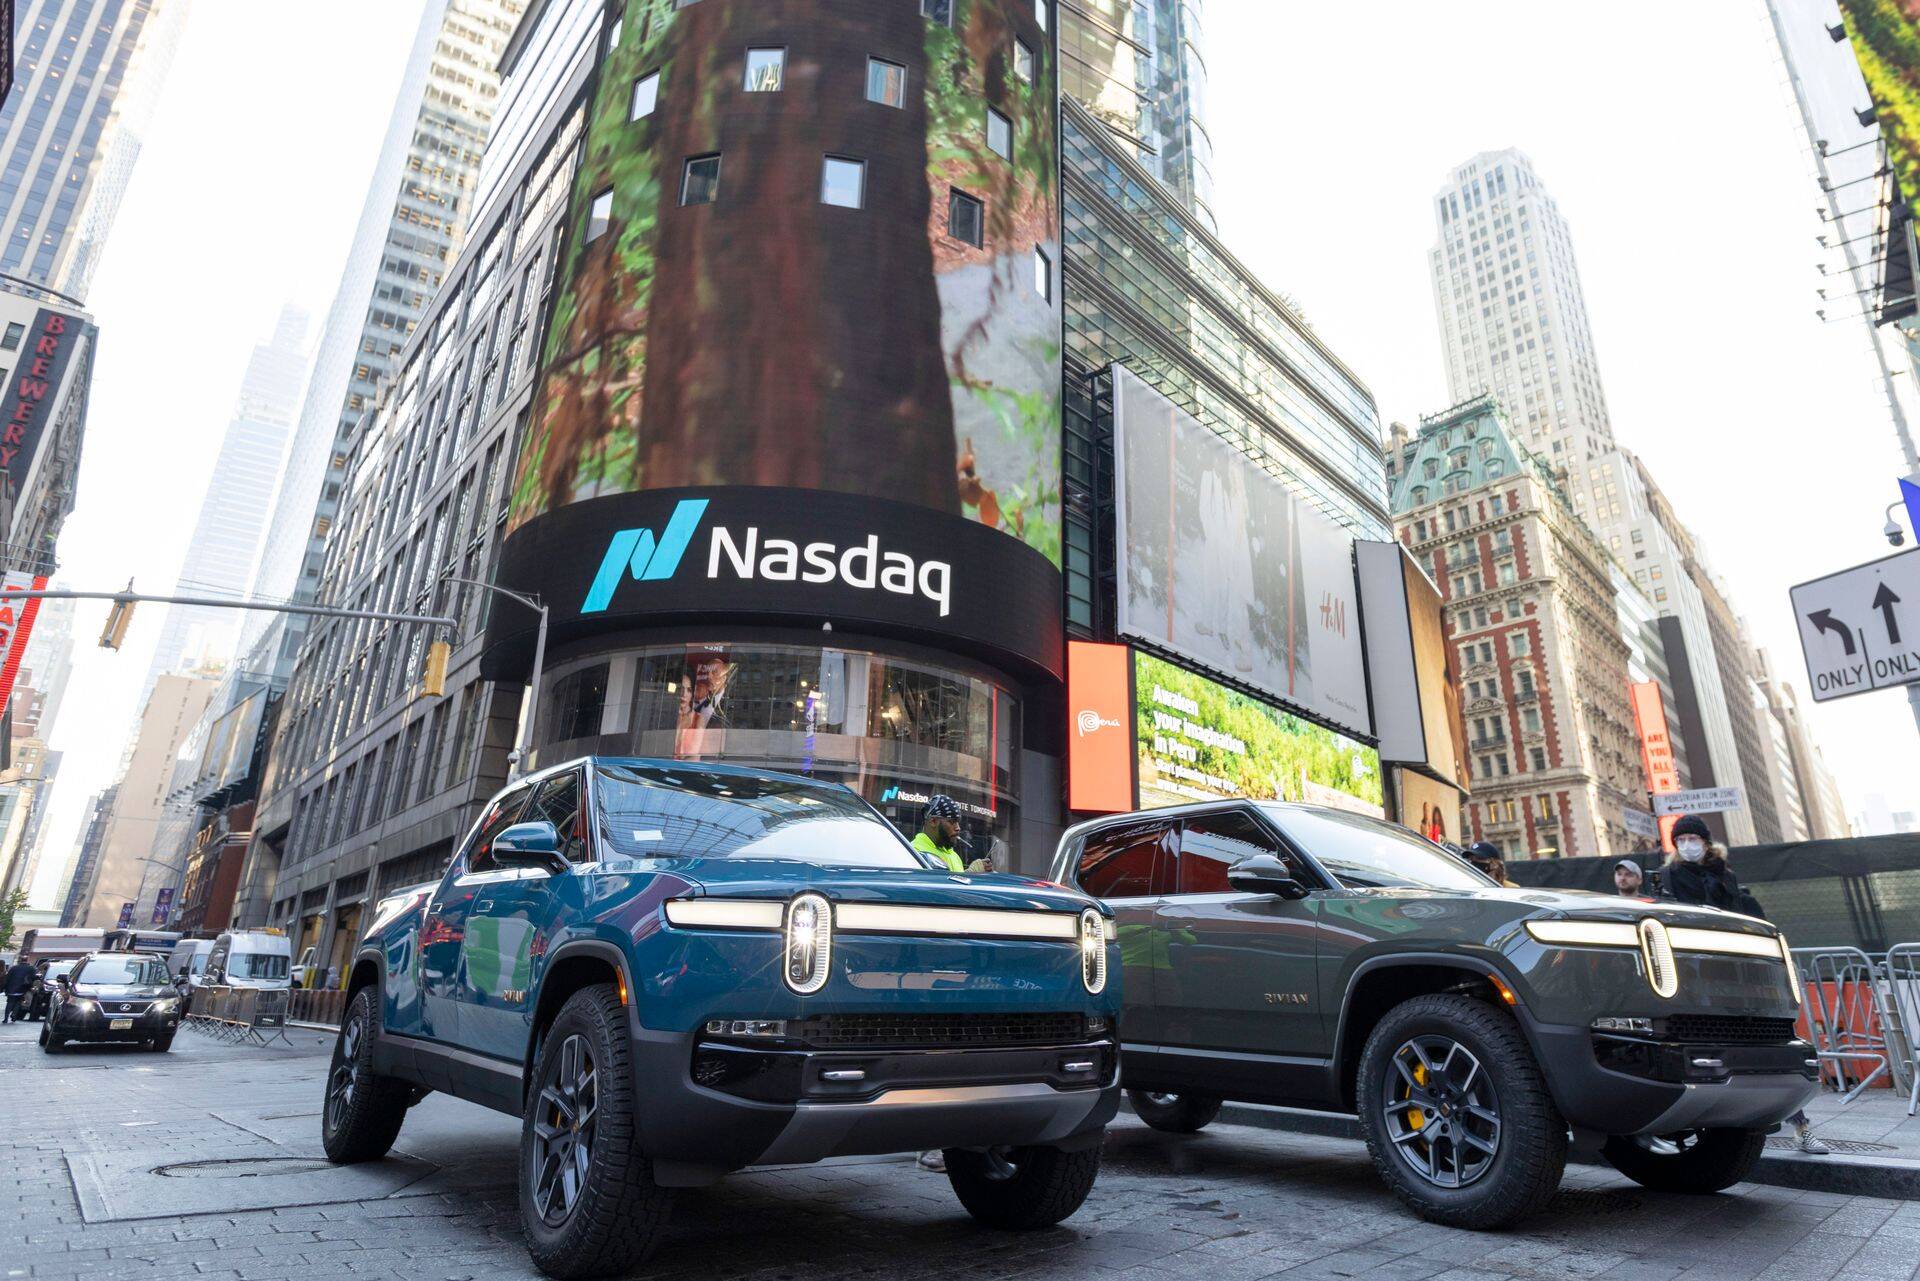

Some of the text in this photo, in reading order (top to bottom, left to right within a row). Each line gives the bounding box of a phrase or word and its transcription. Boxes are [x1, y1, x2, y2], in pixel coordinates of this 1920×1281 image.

[0, 314, 66, 470] BREWERY
[707, 527, 951, 617] Nasdaq
[1320, 590, 1345, 640] H&M
[1817, 664, 1864, 692] ONLY
[1874, 651, 1920, 678] ONLY
[1153, 684, 1198, 716] Awaken
[1153, 710, 1245, 755] your imagination
[1647, 733, 1664, 743] ARE
[1154, 731, 1197, 763] in Peru
[1650, 747, 1668, 757] YOU
[1653, 761, 1670, 772] ALL
[897, 790, 929, 803] Nasdaq
[1263, 993, 1310, 1005] RIVIAN
